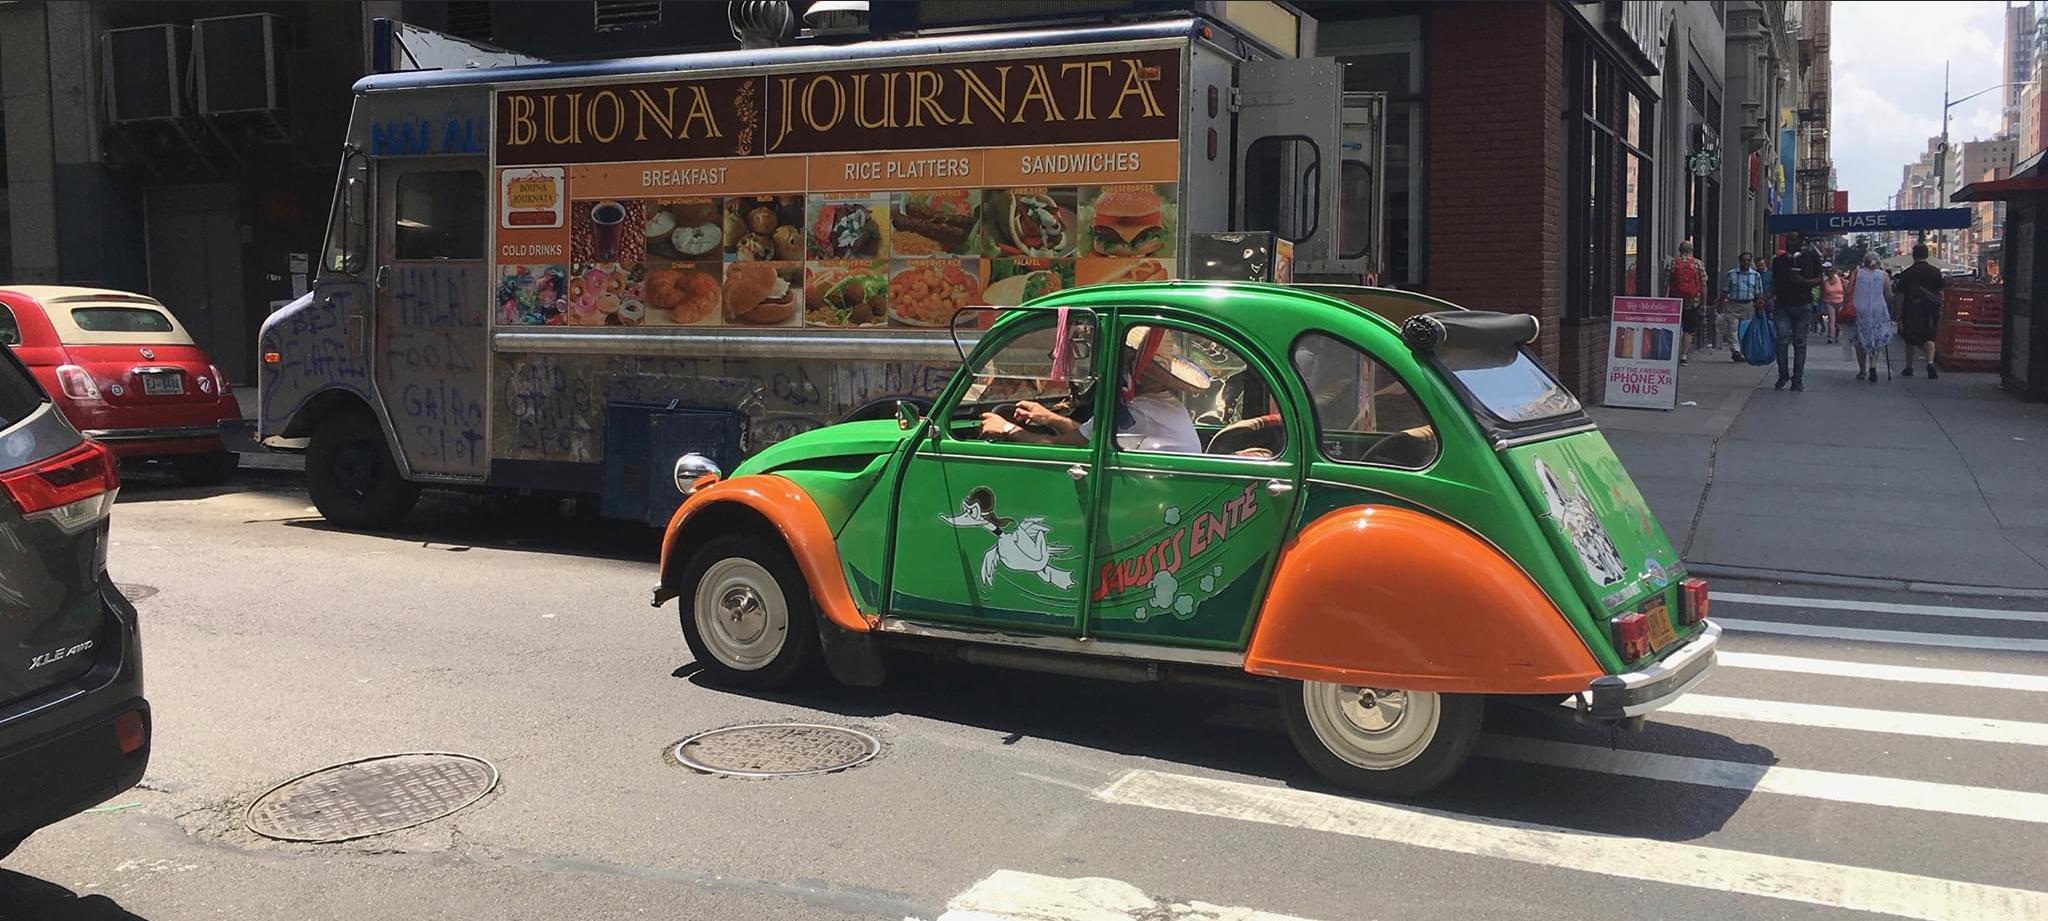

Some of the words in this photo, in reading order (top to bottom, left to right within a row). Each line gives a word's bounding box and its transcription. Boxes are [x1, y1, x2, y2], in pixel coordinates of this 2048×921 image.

[506, 86, 723, 145] BUONA
[769, 59, 1166, 151] JOURNATA
[844, 161, 881, 180] RICE
[887, 157, 970, 179] PLATTERS
[1021, 152, 1141, 175] SANDWICHES
[642, 167, 728, 187] BREAKFAST
[1829, 214, 1888, 228] CHASE
[502, 245, 527, 256] COLD
[529, 244, 562, 255] DRINKS
[1610, 372, 1655, 384] iPHONE
[1622, 383, 1640, 393] ON
[1642, 385, 1658, 395] US
[1189, 480, 1259, 559] ENTE
[27, 647, 66, 671] XLE
[66, 640, 94, 657] AWD
